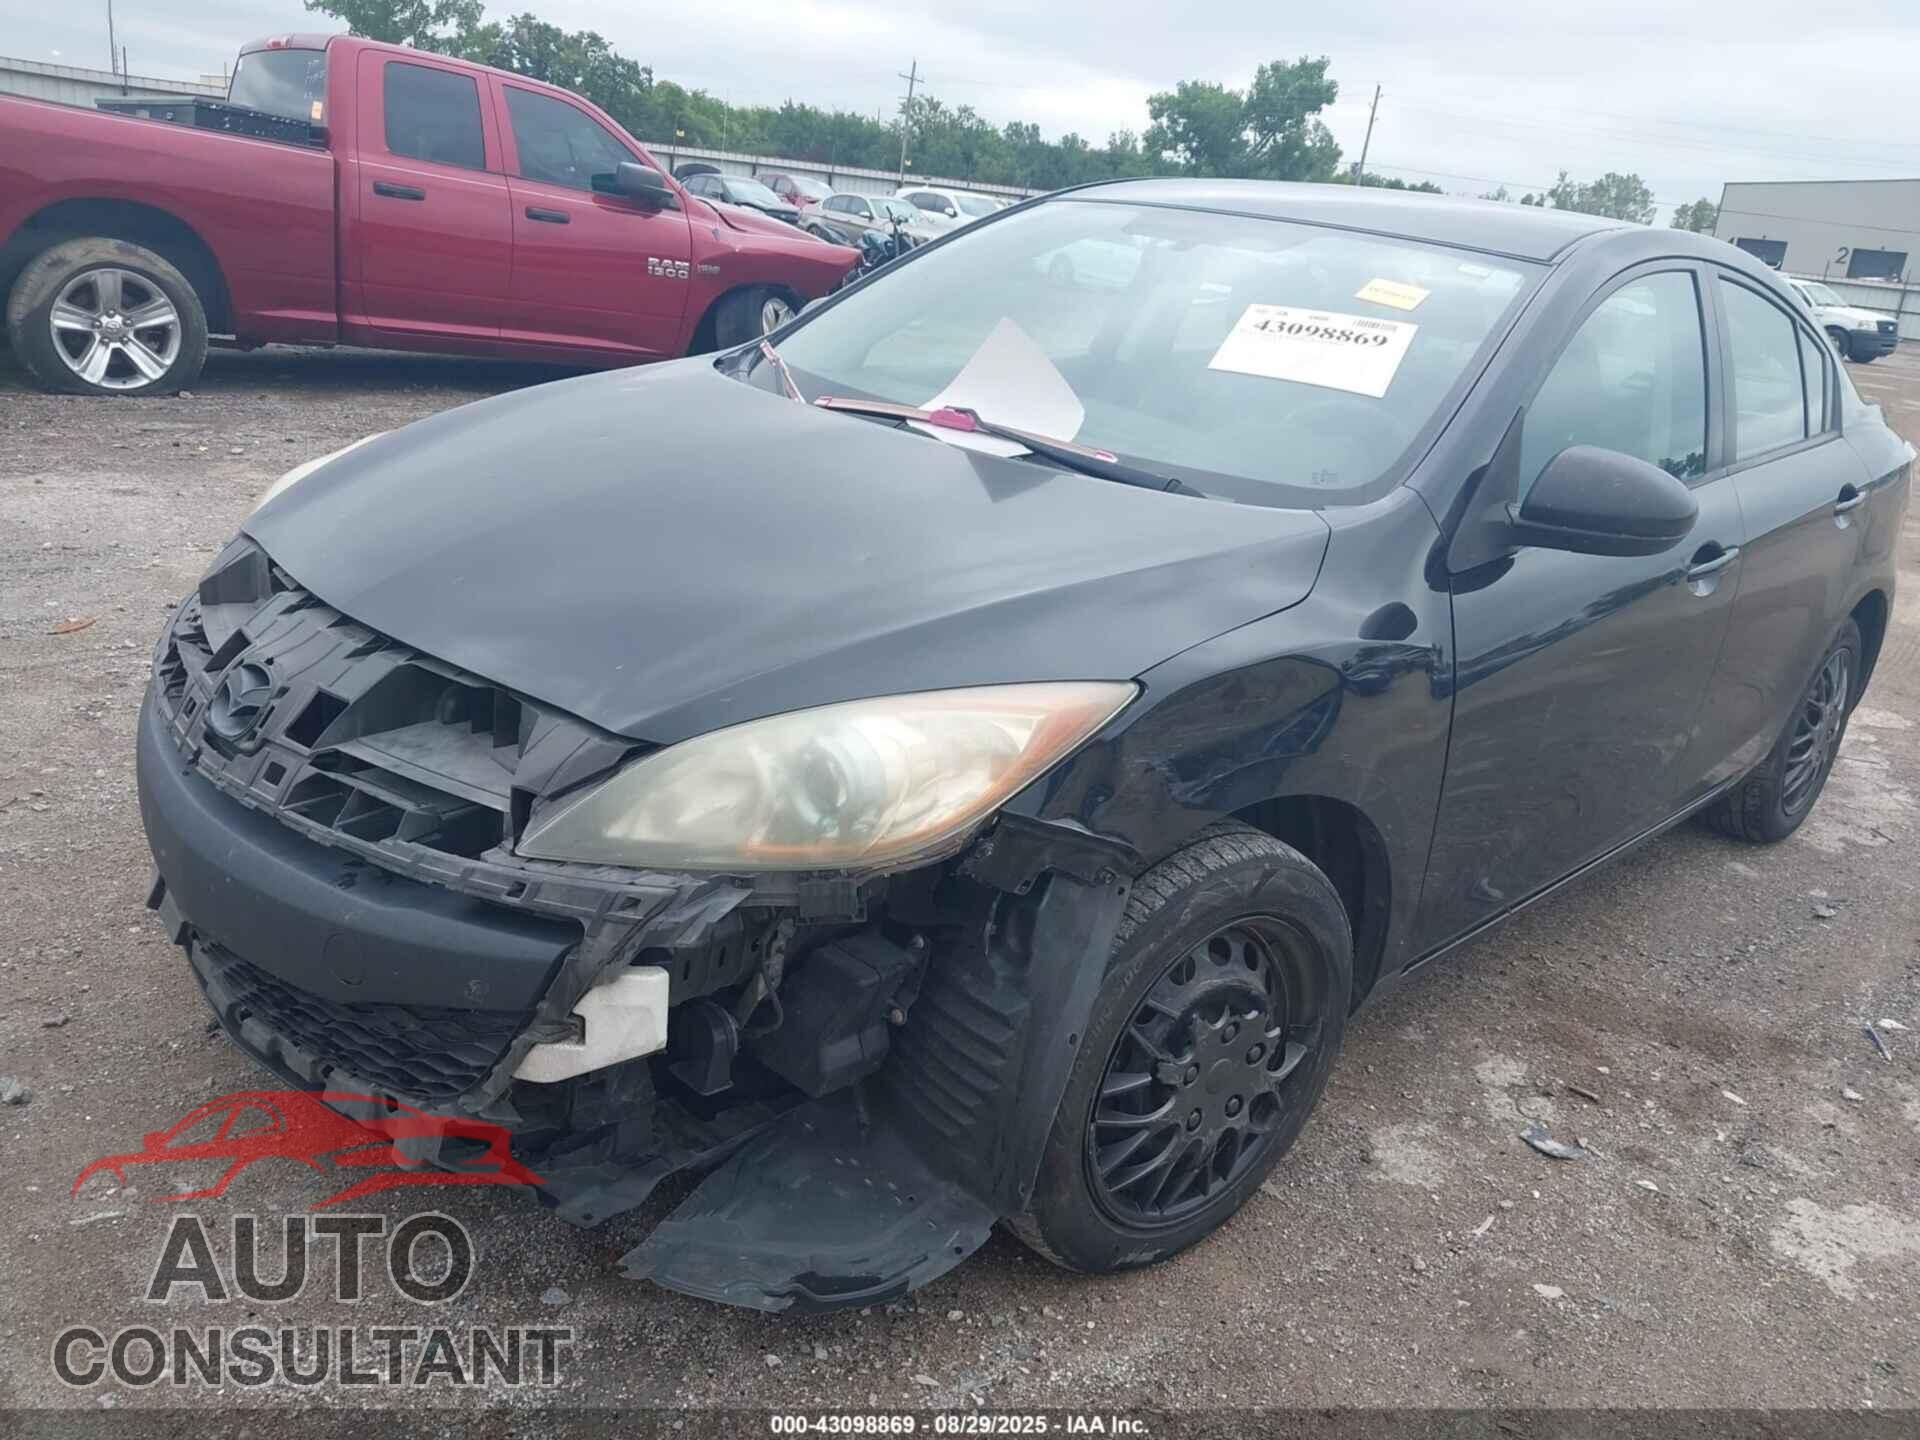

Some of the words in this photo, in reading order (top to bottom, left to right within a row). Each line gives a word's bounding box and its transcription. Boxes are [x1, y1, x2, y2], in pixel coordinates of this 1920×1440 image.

[647, 257, 690, 271] RAM
[1835, 247, 1849, 264] 2
[1253, 319, 1388, 347] 43098869
